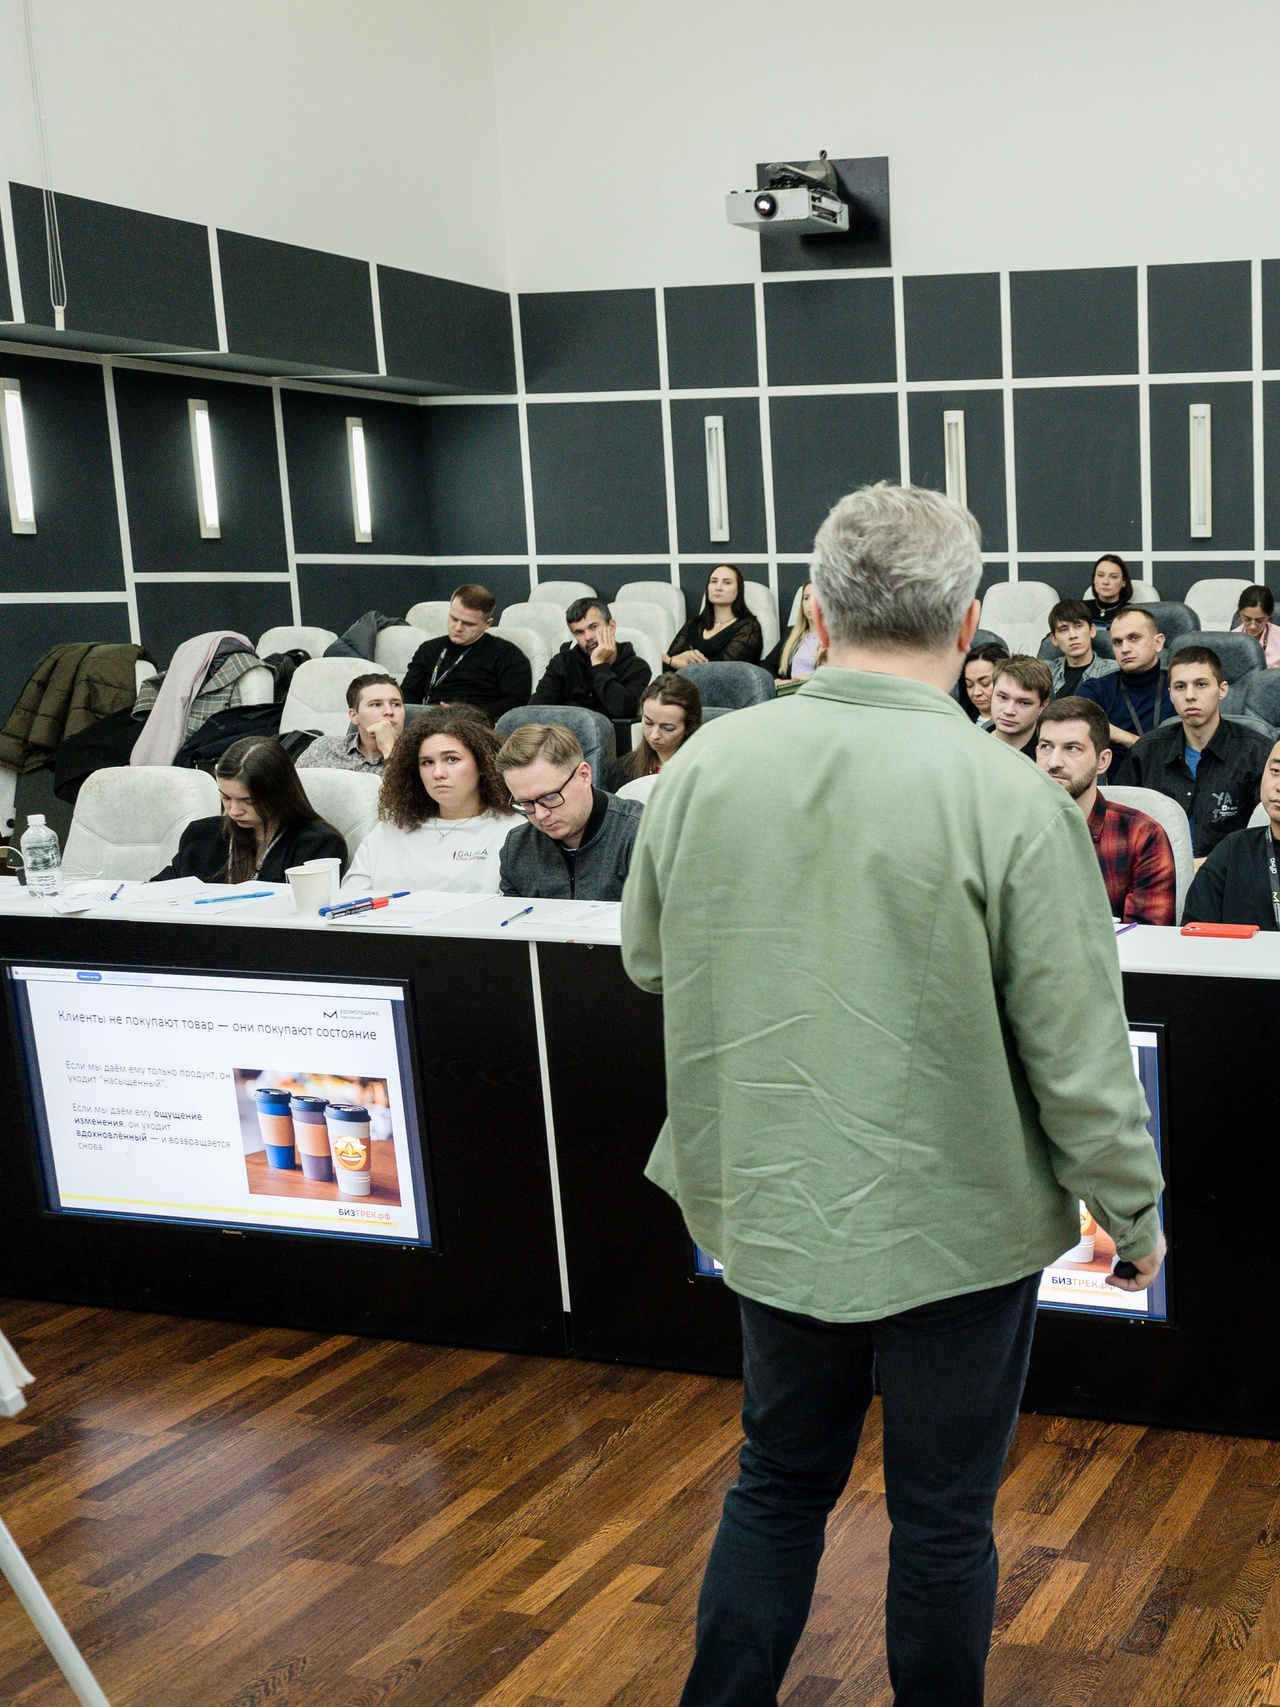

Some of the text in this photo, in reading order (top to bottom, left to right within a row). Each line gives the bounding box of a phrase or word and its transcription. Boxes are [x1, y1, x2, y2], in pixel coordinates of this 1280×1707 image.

[58, 1010, 106, 1024] Клиенты
[109, 1016, 122, 1025] не
[126, 1017, 178, 1029] покупают
[182, 1018, 214, 1032] товар
[232, 1022, 254, 1033] они
[257, 1024, 313, 1037] покупают
[316, 1026, 377, 1041] состояние
[65, 1060, 231, 1080] Если мы даём ему только продукт, он
[67, 1075, 97, 1084] уходит
[72, 1103, 203, 1121] Если мы даём ему ощущение
[74, 1117, 171, 1132] изменения, он уходит
[76, 1129, 148, 1142] вдохновлённый
[161, 1136, 167, 1144] и
[169, 1136, 231, 1149] возвращается
[78, 1142, 106, 1151] снова.
[338, 1208, 391, 1221] БИЗТРЕК.рф
